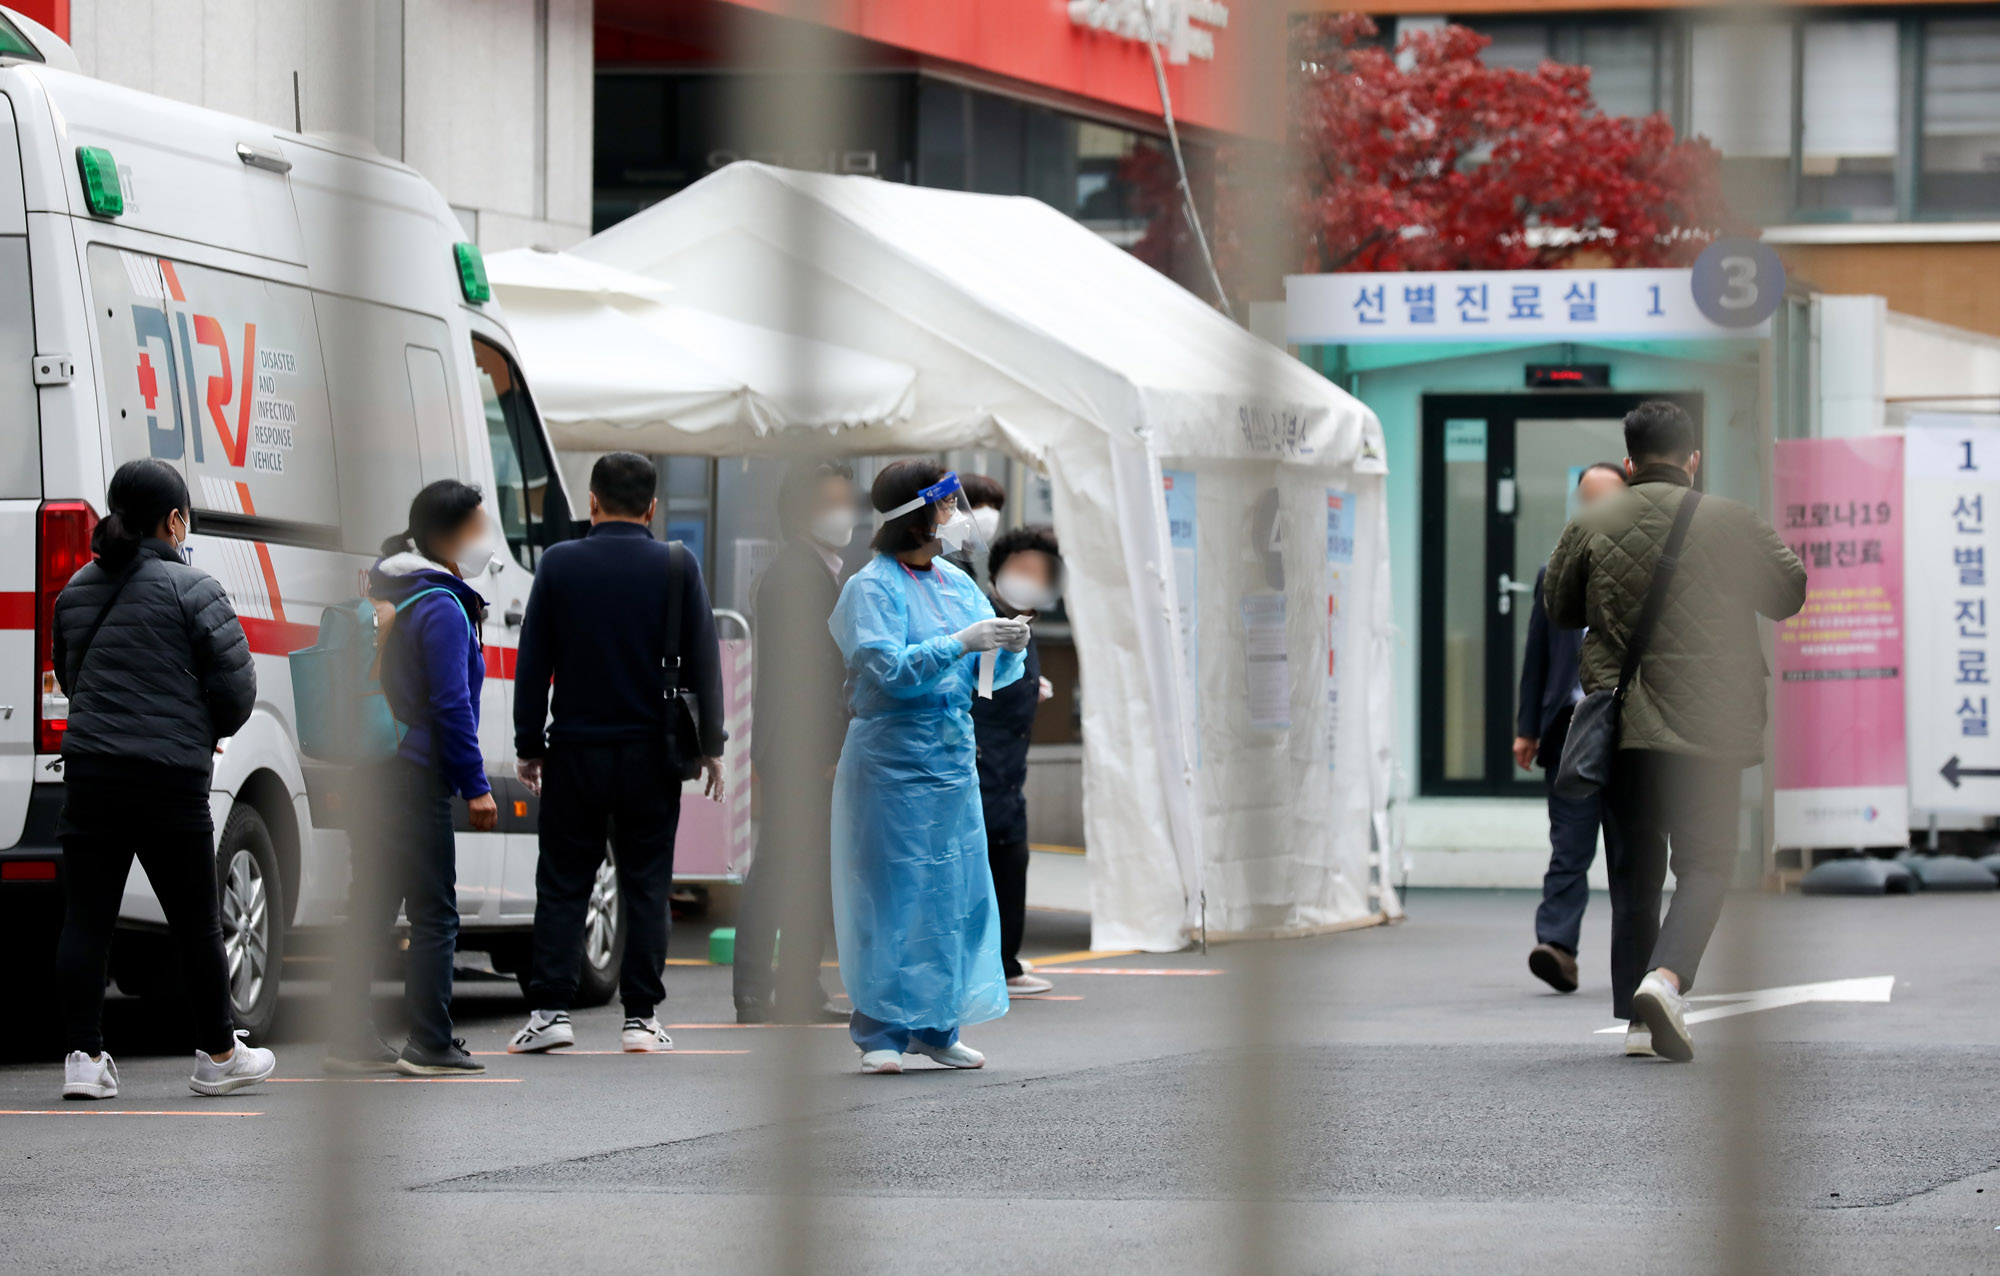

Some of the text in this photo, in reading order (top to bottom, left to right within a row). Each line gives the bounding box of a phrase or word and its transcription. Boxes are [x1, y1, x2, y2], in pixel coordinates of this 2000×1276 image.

[1719, 256, 1759, 309] 3
[1353, 282, 1665, 323] 선별진료실 1
[260, 350, 297, 372] DISASTER
[258, 375, 275, 394] AND
[257, 400, 296, 422] INFECTION
[255, 425, 292, 447] RESPONSE
[252, 451, 282, 471] VEHICLE
[1957, 440, 1978, 471] 1
[1785, 502, 1892, 529] 코로나19
[1952, 494, 1990, 738] 선별진료실
